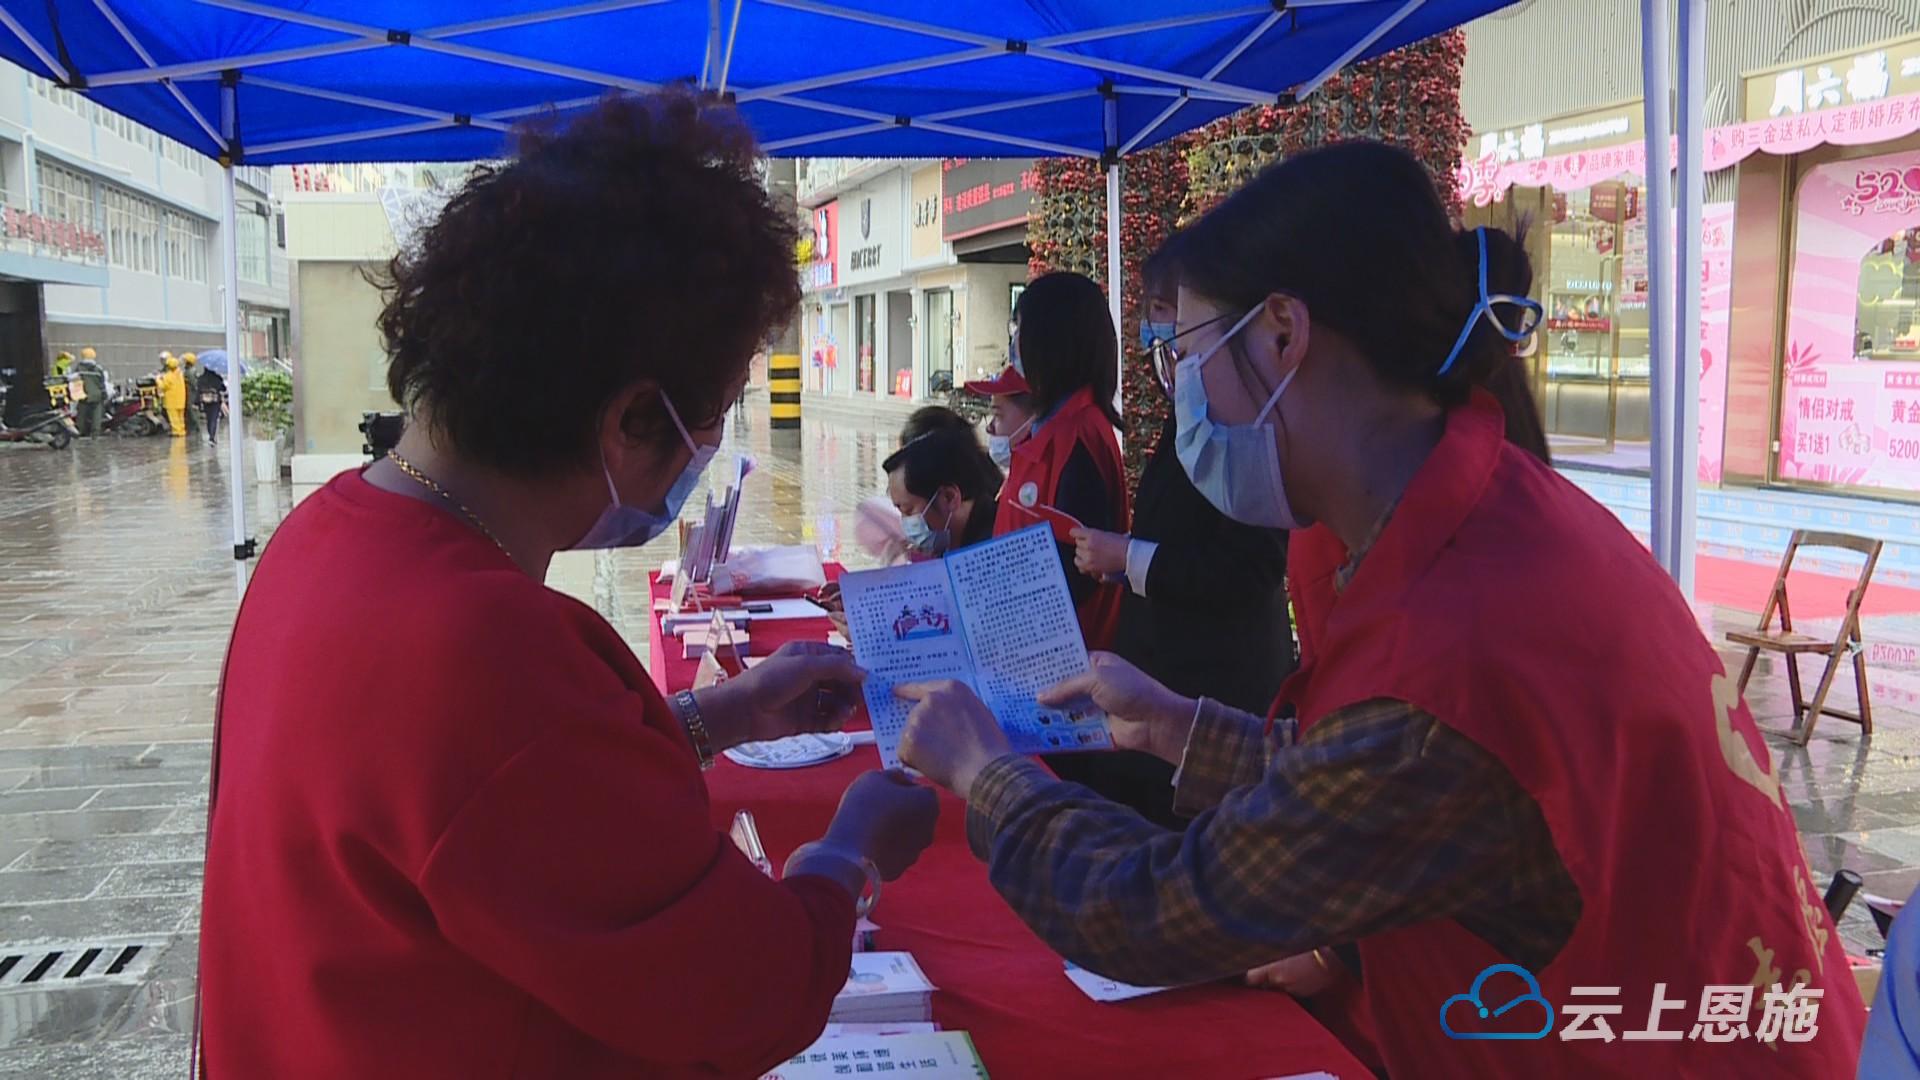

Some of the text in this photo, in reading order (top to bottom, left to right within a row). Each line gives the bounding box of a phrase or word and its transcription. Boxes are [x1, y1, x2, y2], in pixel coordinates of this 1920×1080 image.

[1799, 397, 1854, 420] 情侣对戒
[1798, 431, 1830, 454] 买1送1
